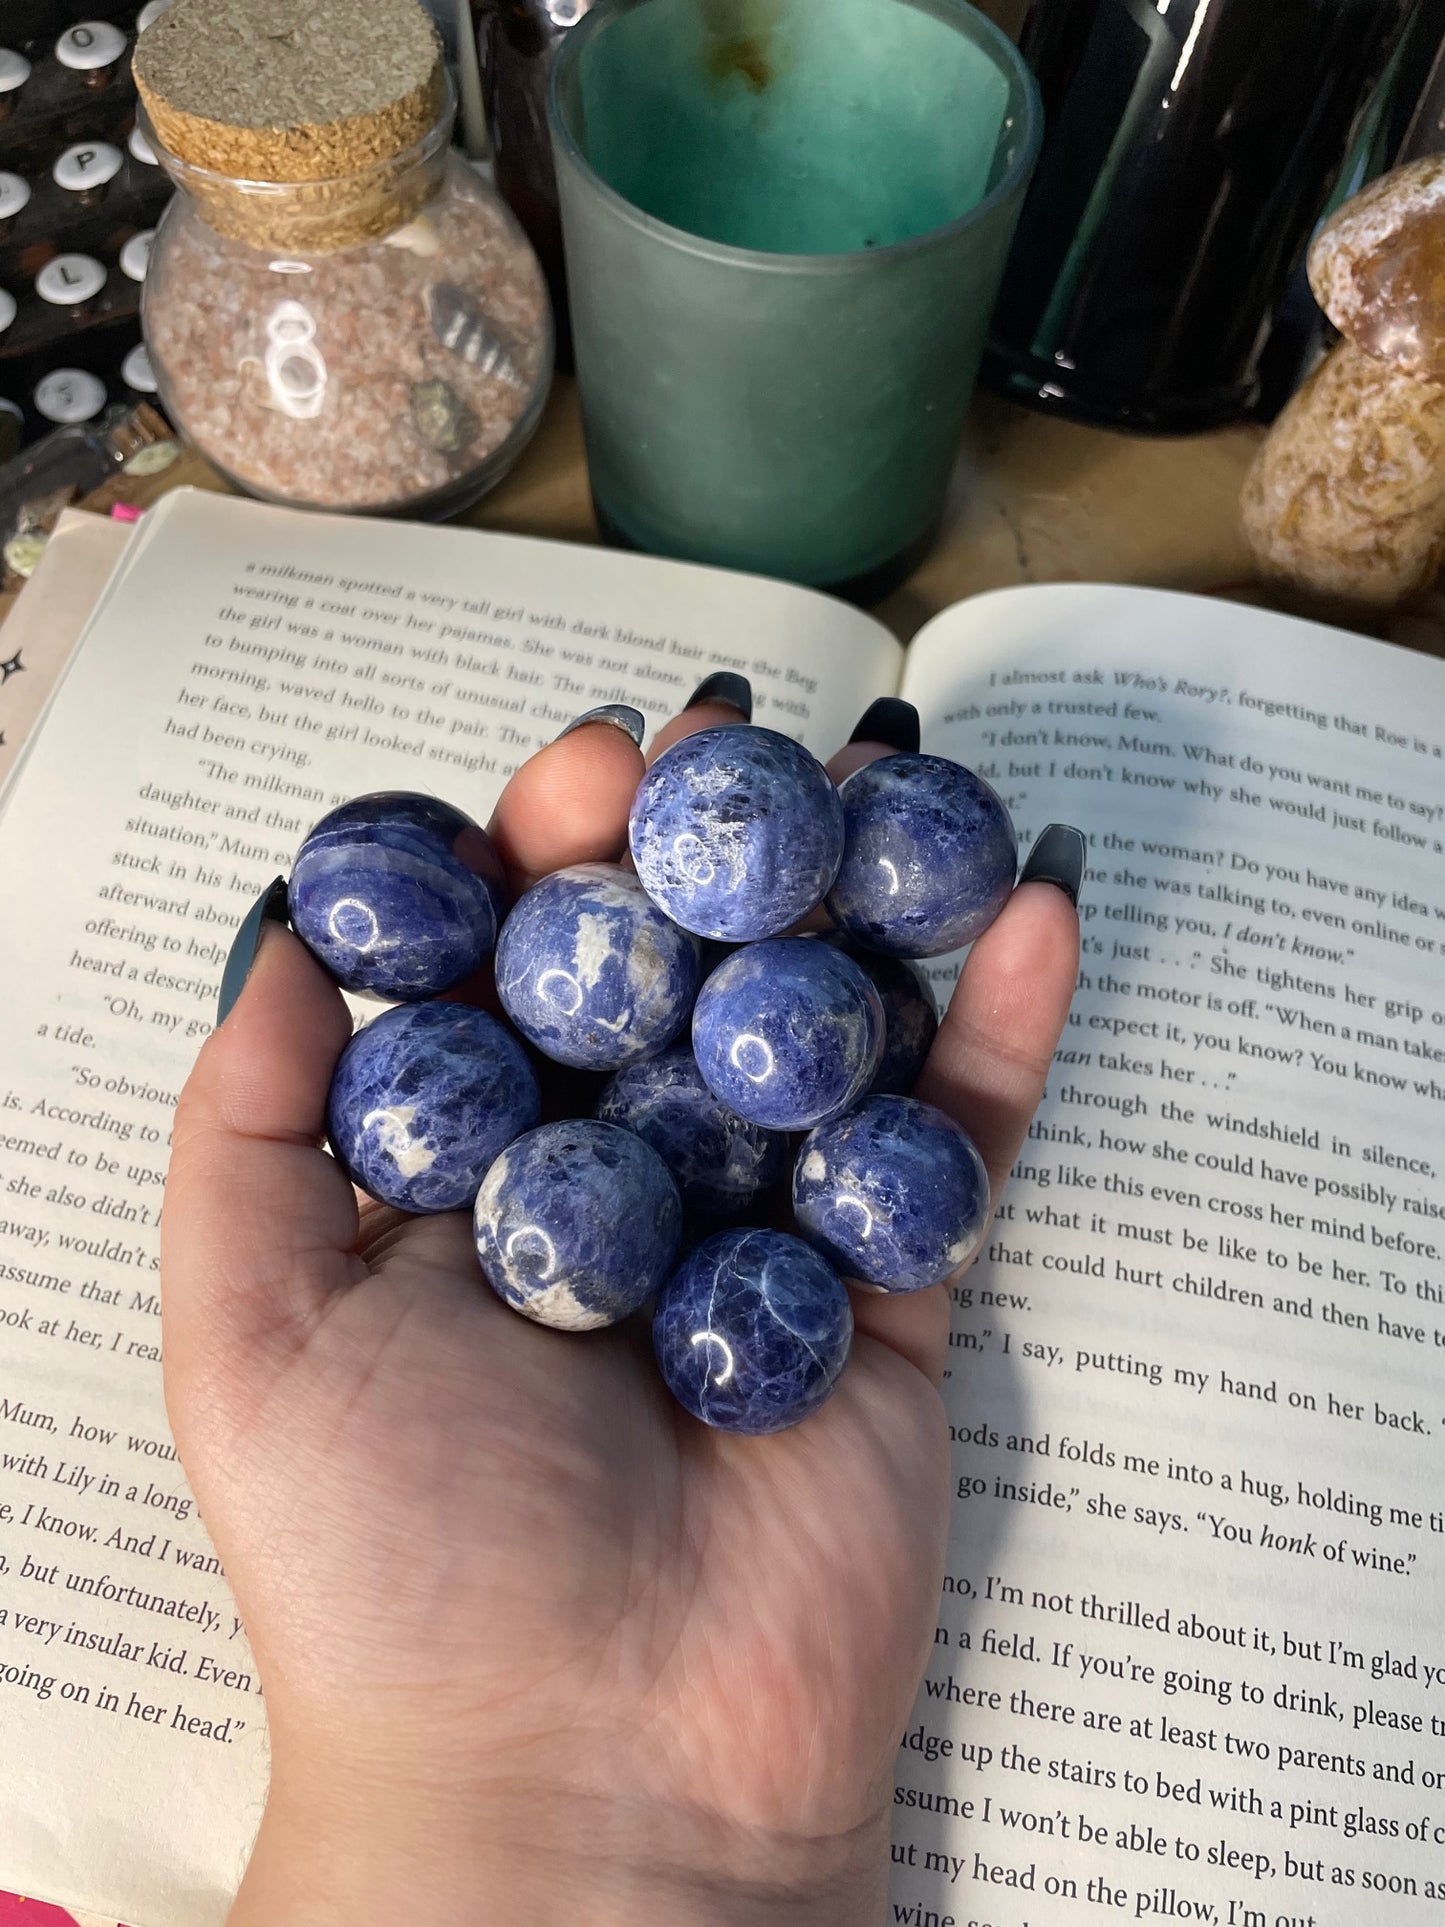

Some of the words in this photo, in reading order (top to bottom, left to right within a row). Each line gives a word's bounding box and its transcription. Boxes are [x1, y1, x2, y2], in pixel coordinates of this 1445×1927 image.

[244, 562, 256, 572] a
[259, 565, 334, 585] milkman
[336, 578, 403, 598] spotted
[404, 590, 416, 600] a
[420, 593, 458, 611] very
[461, 599, 491, 615] tall
[491, 607, 525, 621] girl
[528, 613, 566, 631] with
[568, 620, 609, 640] dark
[668, 639, 705, 660] hair
[751, 659, 781, 678] the
[218, 606, 246, 623] the
[248, 614, 282, 630] girl
[287, 621, 319, 638] was
[323, 630, 334, 641] a
[341, 633, 403, 656] woman
[410, 647, 448, 665] with
[454, 653, 499, 676] black
[505, 664, 542, 685] hair.
[553, 674, 584, 694] The
[589, 687, 672, 715] milkman,
[176, 686, 209, 708] her
[212, 697, 251, 719] face,
[258, 704, 288, 726] but
[294, 714, 322, 733] the
[325, 724, 359, 741] girl
[361, 728, 425, 756] looked
[428, 747, 496, 772] straight
[942, 703, 981, 724] with
[984, 697, 1028, 719] only
[1030, 701, 1042, 714] a
[1047, 700, 1118, 717] trusted
[1123, 701, 1161, 723] few.
[163, 717, 200, 740] had
[202, 725, 245, 750] been
[248, 740, 310, 768] crying.
[138, 782, 220, 813] daughter
[225, 806, 261, 823] and
[265, 811, 300, 832] that
[1054, 729, 1111, 749] know,
[1117, 735, 1175, 757] Mum.
[1182, 743, 1235, 768] What
[1239, 755, 1264, 774] do
[1268, 763, 1302, 784] you
[1306, 772, 1350, 796] want
[1355, 786, 1383, 804] me
[1386, 793, 1405, 810] to
[1408, 800, 1444, 823] say?
[111, 851, 162, 874] stuck
[168, 861, 186, 879] in
[194, 865, 222, 886] his
[84, 918, 158, 951] offering
[162, 935, 181, 952] to
[1104, 903, 1168, 932] telling
[1174, 916, 1216, 937] you,
[1222, 921, 1230, 939] I
[36, 1024, 48, 1036] a
[54, 1024, 95, 1048] tide.
[1, 1090, 22, 1110] is.
[29, 1098, 135, 1141] According
[139, 1124, 160, 1143] to
[1060, 1084, 1147, 1117] through
[1160, 1100, 1194, 1123] the
[1206, 1112, 1320, 1150] windshield
[1332, 1135, 1350, 1157] in
[1362, 1145, 1435, 1178] silence,
[5, 1175, 42, 1198] she
[44, 1184, 86, 1209] also
[1057, 1164, 1096, 1189] like
[1104, 1172, 1143, 1196] this
[1150, 1186, 1200, 1208] even
[1207, 1197, 1263, 1220] cross
[1270, 1202, 1304, 1229] her
[1310, 1217, 1365, 1243] mind
[1370, 1225, 1440, 1260] before.
[79, 1279, 122, 1306] that
[988, 1241, 1032, 1266] that
[1042, 1254, 1104, 1278] could
[1114, 1259, 1163, 1288] hurt
[1172, 1272, 1264, 1308] children
[1272, 1297, 1313, 1319] and
[1322, 1302, 1368, 1330] then
[1378, 1312, 1425, 1343] have
[37, 1319, 60, 1336] at
[63, 1319, 102, 1350] her,
[109, 1332, 123, 1351] I
[1002, 1333, 1010, 1354] I
[1022, 1342, 1063, 1367] say,
[1076, 1350, 1162, 1386] putting
[1174, 1368, 1209, 1394] my
[1220, 1370, 1277, 1403] hand
[1288, 1391, 1316, 1411] on
[1327, 1392, 1364, 1420] her
[1374, 1402, 1430, 1435] back.
[2, 1453, 47, 1479] with
[51, 1461, 96, 1495] Lily
[97, 1473, 120, 1497] in
[124, 1485, 137, 1502] a
[141, 1482, 193, 1520] long
[19, 1503, 33, 1525] I
[33, 1506, 98, 1543] know.
[102, 1526, 156, 1557] And
[156, 1539, 170, 1561] I
[957, 1477, 986, 1498] go
[1086, 1492, 1126, 1519] she
[1133, 1506, 1188, 1534] says.
[1259, 1524, 1317, 1557] honk
[1322, 1539, 1347, 1563] of
[0, 1609, 8, 1625] a
[14, 1612, 63, 1645] very
[62, 1621, 145, 1662] insular
[145, 1641, 187, 1675] kid.
[193, 1655, 251, 1691] Even
[60, 1682, 89, 1704] on
[94, 1685, 119, 1712] in
[124, 1691, 167, 1724] her
[926, 1675, 1001, 1710] where
[1009, 1689, 1075, 1724] there
[1082, 1710, 1121, 1733] are
[1129, 1717, 1153, 1739] at
[1159, 1715, 1217, 1751] least
[1224, 1732, 1270, 1760] two
[1278, 1745, 1365, 1777] parents
[1372, 1759, 1414, 1785] and
[981, 1797, 990, 1823] I
[1078, 1814, 1108, 1845] be
[1115, 1823, 1167, 1855] able
[1174, 1836, 1199, 1861] to
[1206, 1839, 1276, 1880] sleep,
[1284, 1850, 1324, 1881] but
[1330, 1866, 1354, 1886] as
[1361, 1870, 1417, 1896] soon
